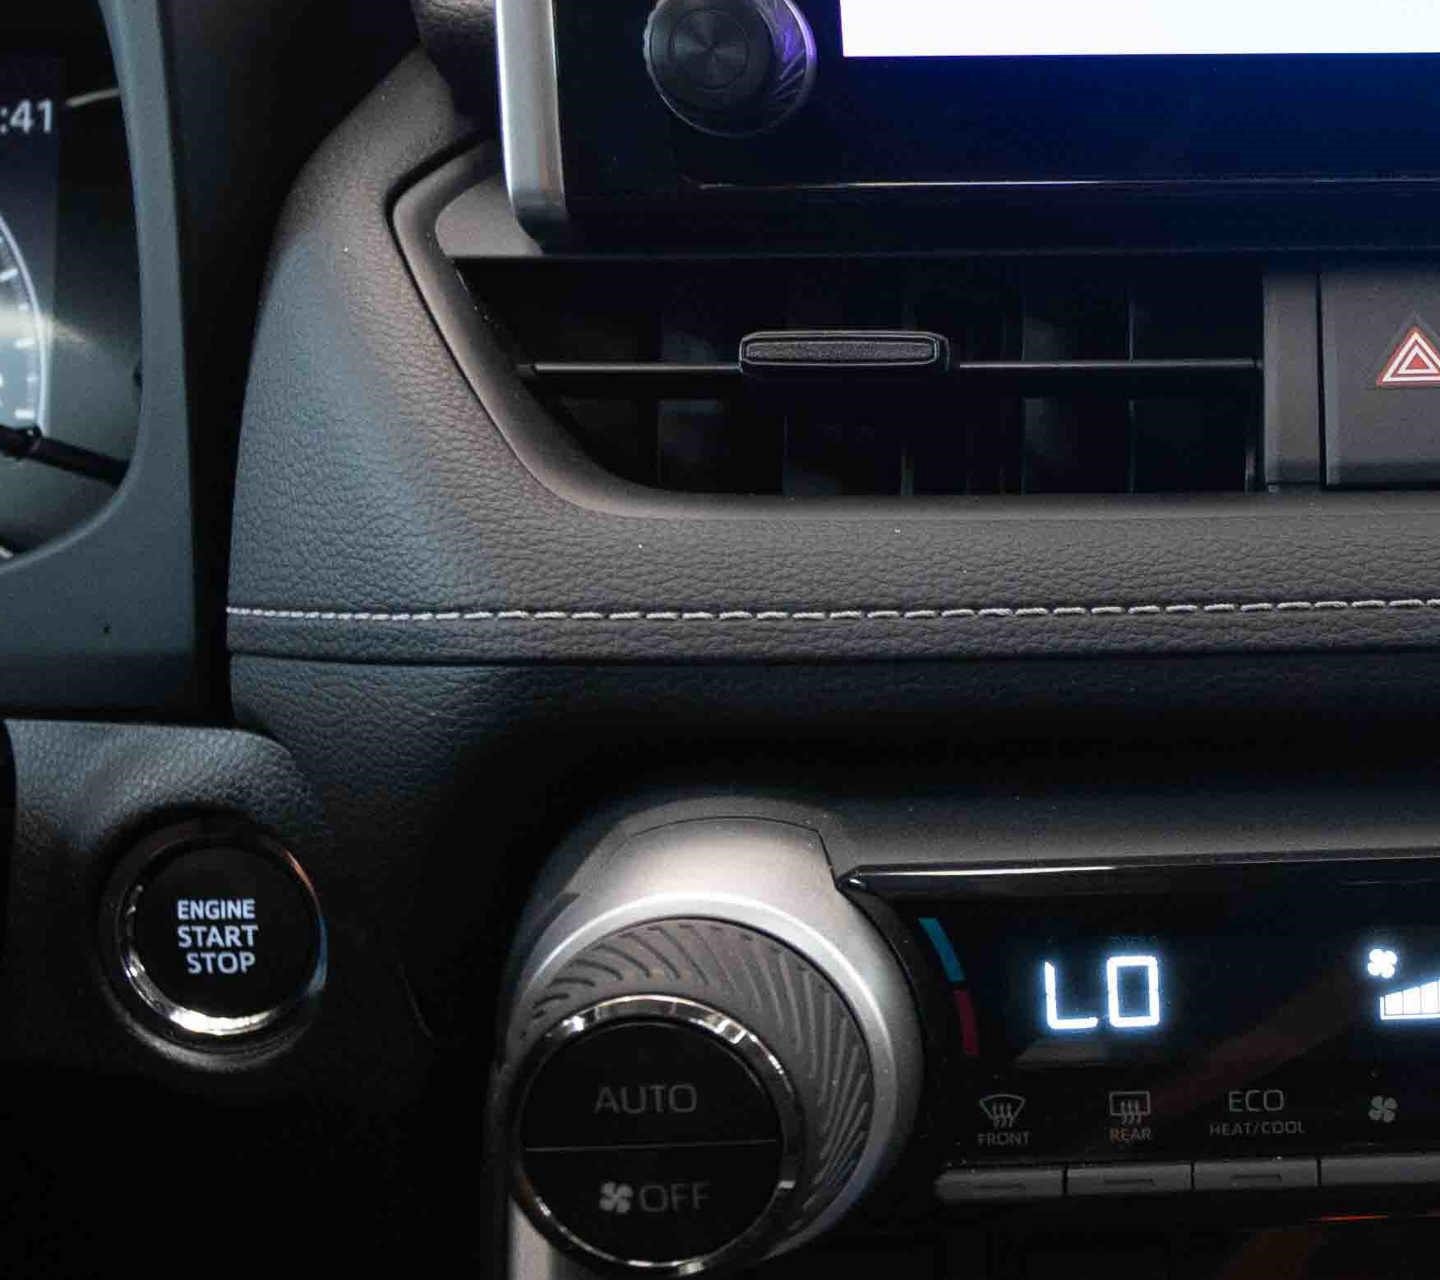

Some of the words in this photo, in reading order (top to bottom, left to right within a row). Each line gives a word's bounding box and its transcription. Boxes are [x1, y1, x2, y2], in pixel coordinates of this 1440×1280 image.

[177, 898, 256, 920] ENGINE
[177, 925, 259, 948] START
[186, 952, 256, 975] STOP
[1043, 954, 1160, 1030] LO
[594, 1083, 698, 1115] AUTO
[1227, 1089, 1285, 1114] ECO
[977, 1130, 1030, 1146] FRONT
[1109, 1125, 1151, 1142] REAR
[1209, 1121, 1306, 1137] HEAT/COOL
[639, 1181, 710, 1213] OFF
